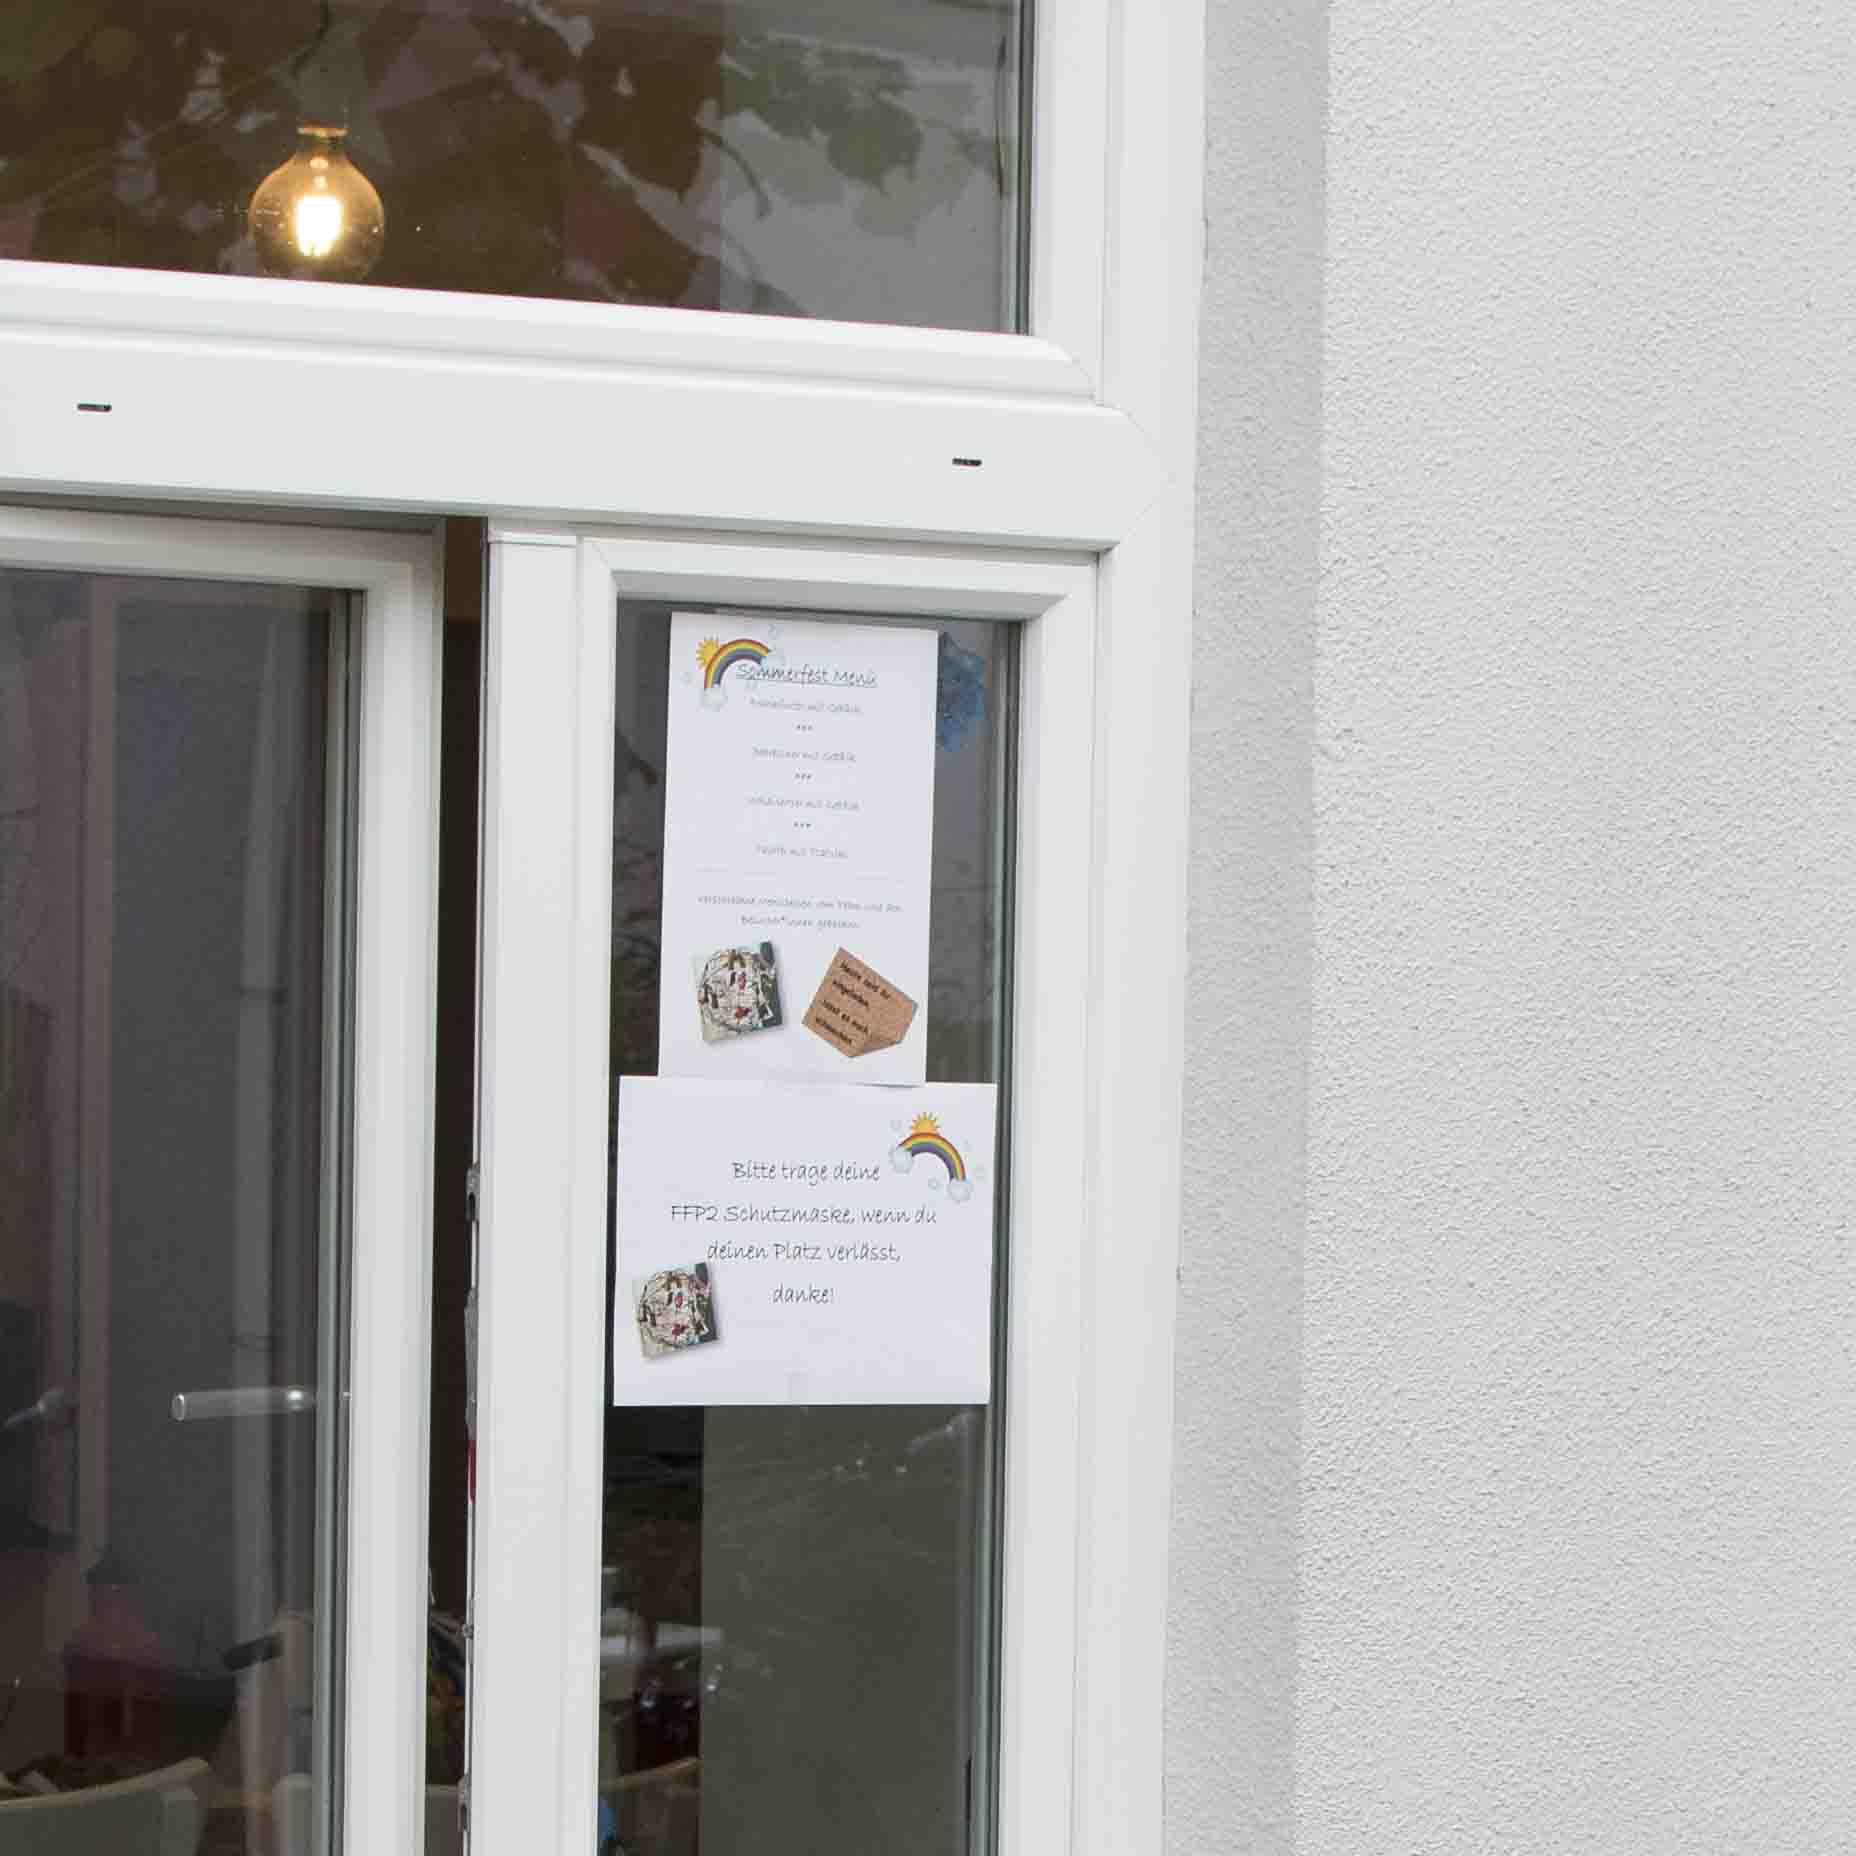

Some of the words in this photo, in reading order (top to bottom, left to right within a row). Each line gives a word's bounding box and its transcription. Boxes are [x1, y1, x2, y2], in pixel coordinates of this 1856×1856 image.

[735, 663, 831, 687] Sommerfest
[732, 1160, 776, 1180] Bitte
[780, 1161, 828, 1187] trage
[832, 1161, 881, 1182] deine
[671, 1204, 719, 1223] FFP2
[722, 1204, 856, 1226] Schutzmaske,
[860, 1209, 912, 1224] wenn
[914, 1206, 937, 1225] du
[706, 1241, 769, 1261] deinen
[773, 1242, 822, 1261] Platz
[826, 1242, 902, 1264] verlässt,
